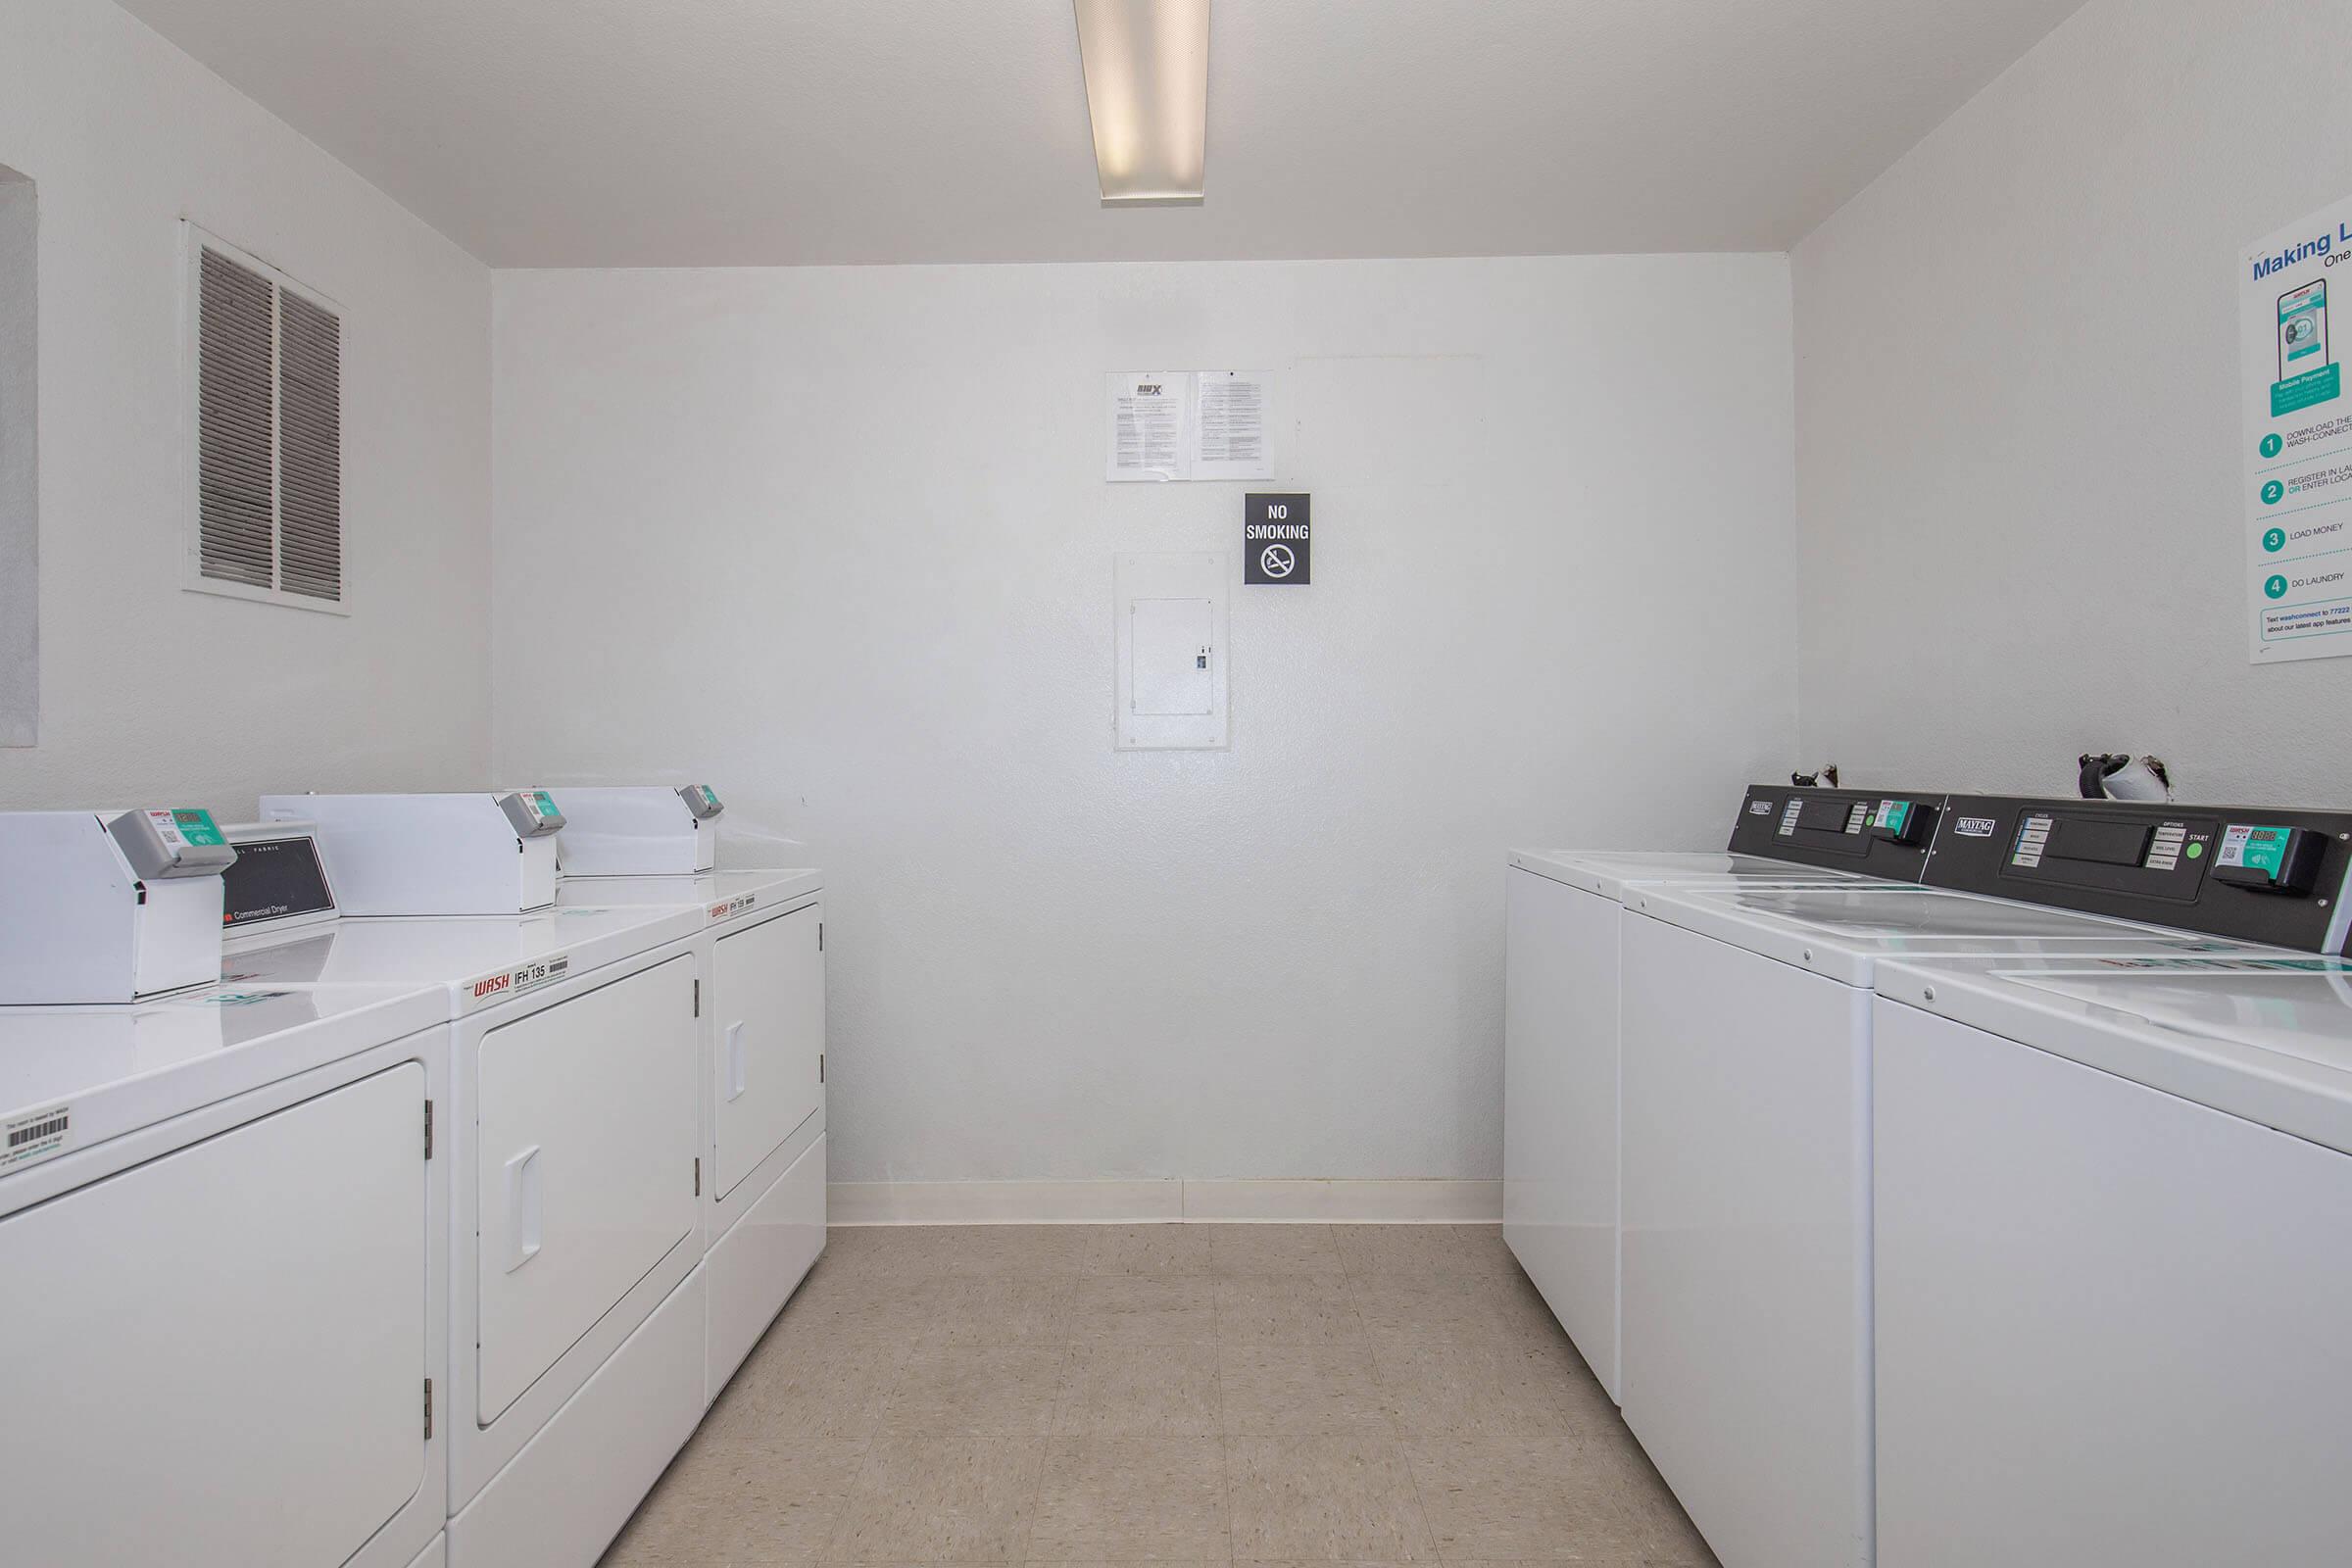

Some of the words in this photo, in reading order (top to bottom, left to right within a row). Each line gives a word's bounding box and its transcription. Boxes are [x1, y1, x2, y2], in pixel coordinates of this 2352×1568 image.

[2253, 233, 2331, 281] Making
[2324, 250, 2351, 268] One
[2278, 378, 2301, 391] Mobile
[2301, 368, 2330, 383] Payment
[2286, 420, 2334, 441] DOWNLOAD
[2336, 415, 2352, 425] THE
[2267, 438, 2275, 451] 1
[2287, 470, 2328, 486] REGISTER
[2328, 467, 2337, 477] IN
[2268, 484, 2278, 499] 2
[2288, 485, 2301, 495] OR
[2302, 478, 2328, 491] ENTER
[1268, 505, 1288, 519] NO
[1246, 524, 1309, 540] SMOKING
[2270, 532, 2279, 546] 3
[2289, 529, 2312, 540] LOAD
[2313, 522, 2344, 535] MONEY
[2272, 579, 2281, 592] 4
[2291, 578, 2305, 588] DO
[2305, 572, 2345, 586] LAUNDRY
[1958, 819, 1992, 832] MAYTAG
[254, 845, 280, 854] FABRIC
[234, 906, 271, 920] Commercial
[270, 905, 289, 915] Dryer
[474, 974, 510, 998] WASH
[514, 970, 529, 985] IFH
[531, 964, 546, 980] 135
